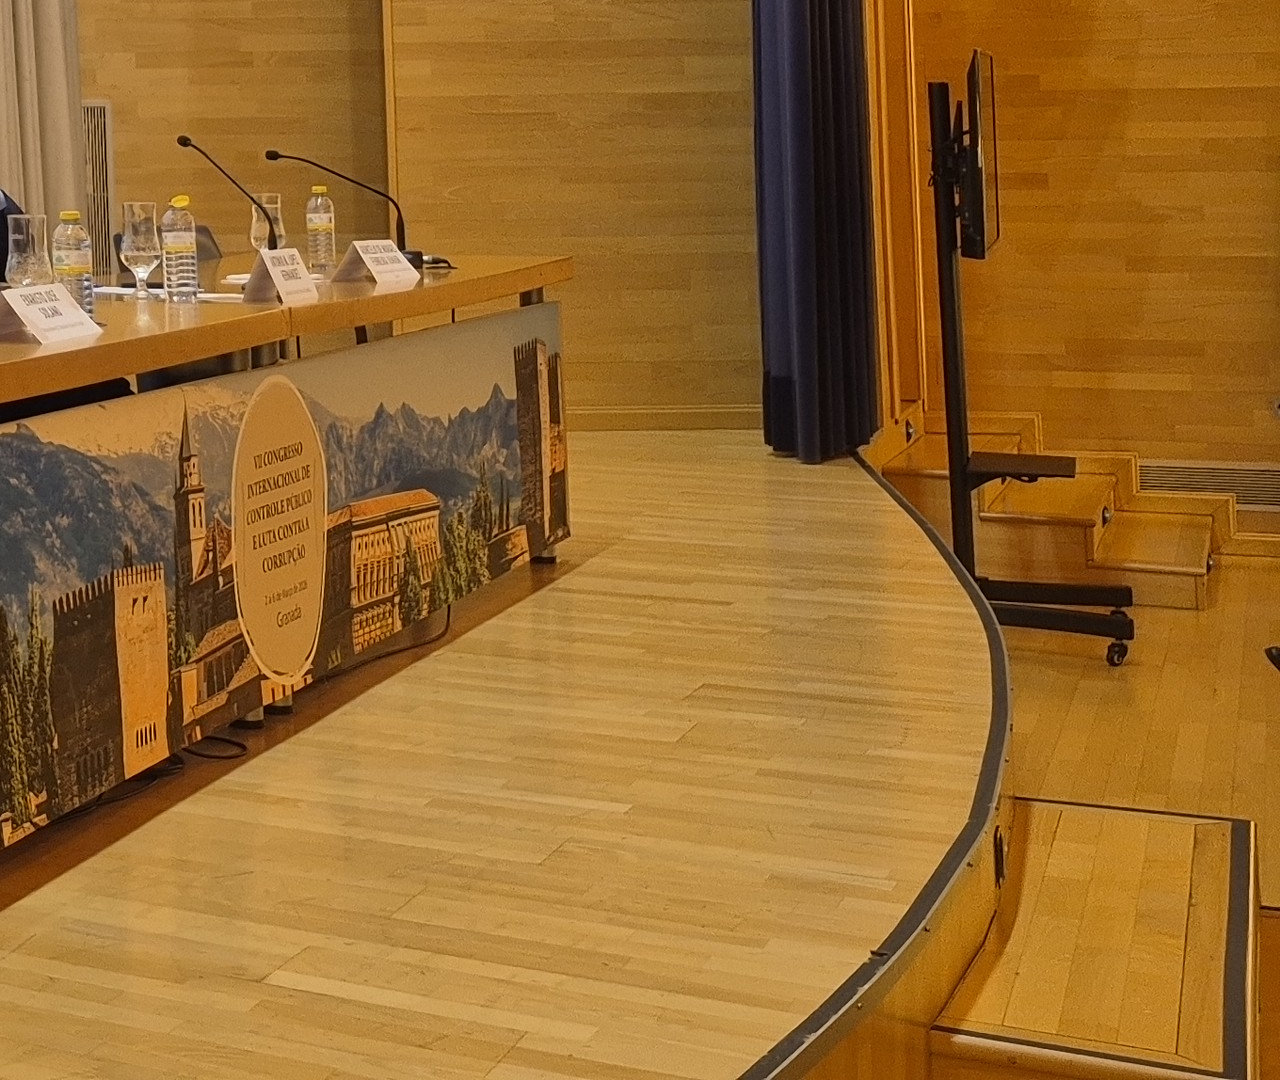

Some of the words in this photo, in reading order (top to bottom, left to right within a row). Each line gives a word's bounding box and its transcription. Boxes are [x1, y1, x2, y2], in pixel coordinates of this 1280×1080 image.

[263, 441, 303, 467] CONGRESSO
[247, 467, 300, 500] INTERNACIONAL
[301, 465, 311, 481] DE
[246, 503, 286, 526] CONTROLE
[286, 488, 313, 512] PÚBLICO
[252, 535, 258, 551] E
[258, 529, 278, 549] LUTA
[262, 543, 306, 573] CORRUPÇÃO
[276, 603, 302, 628] Granada
